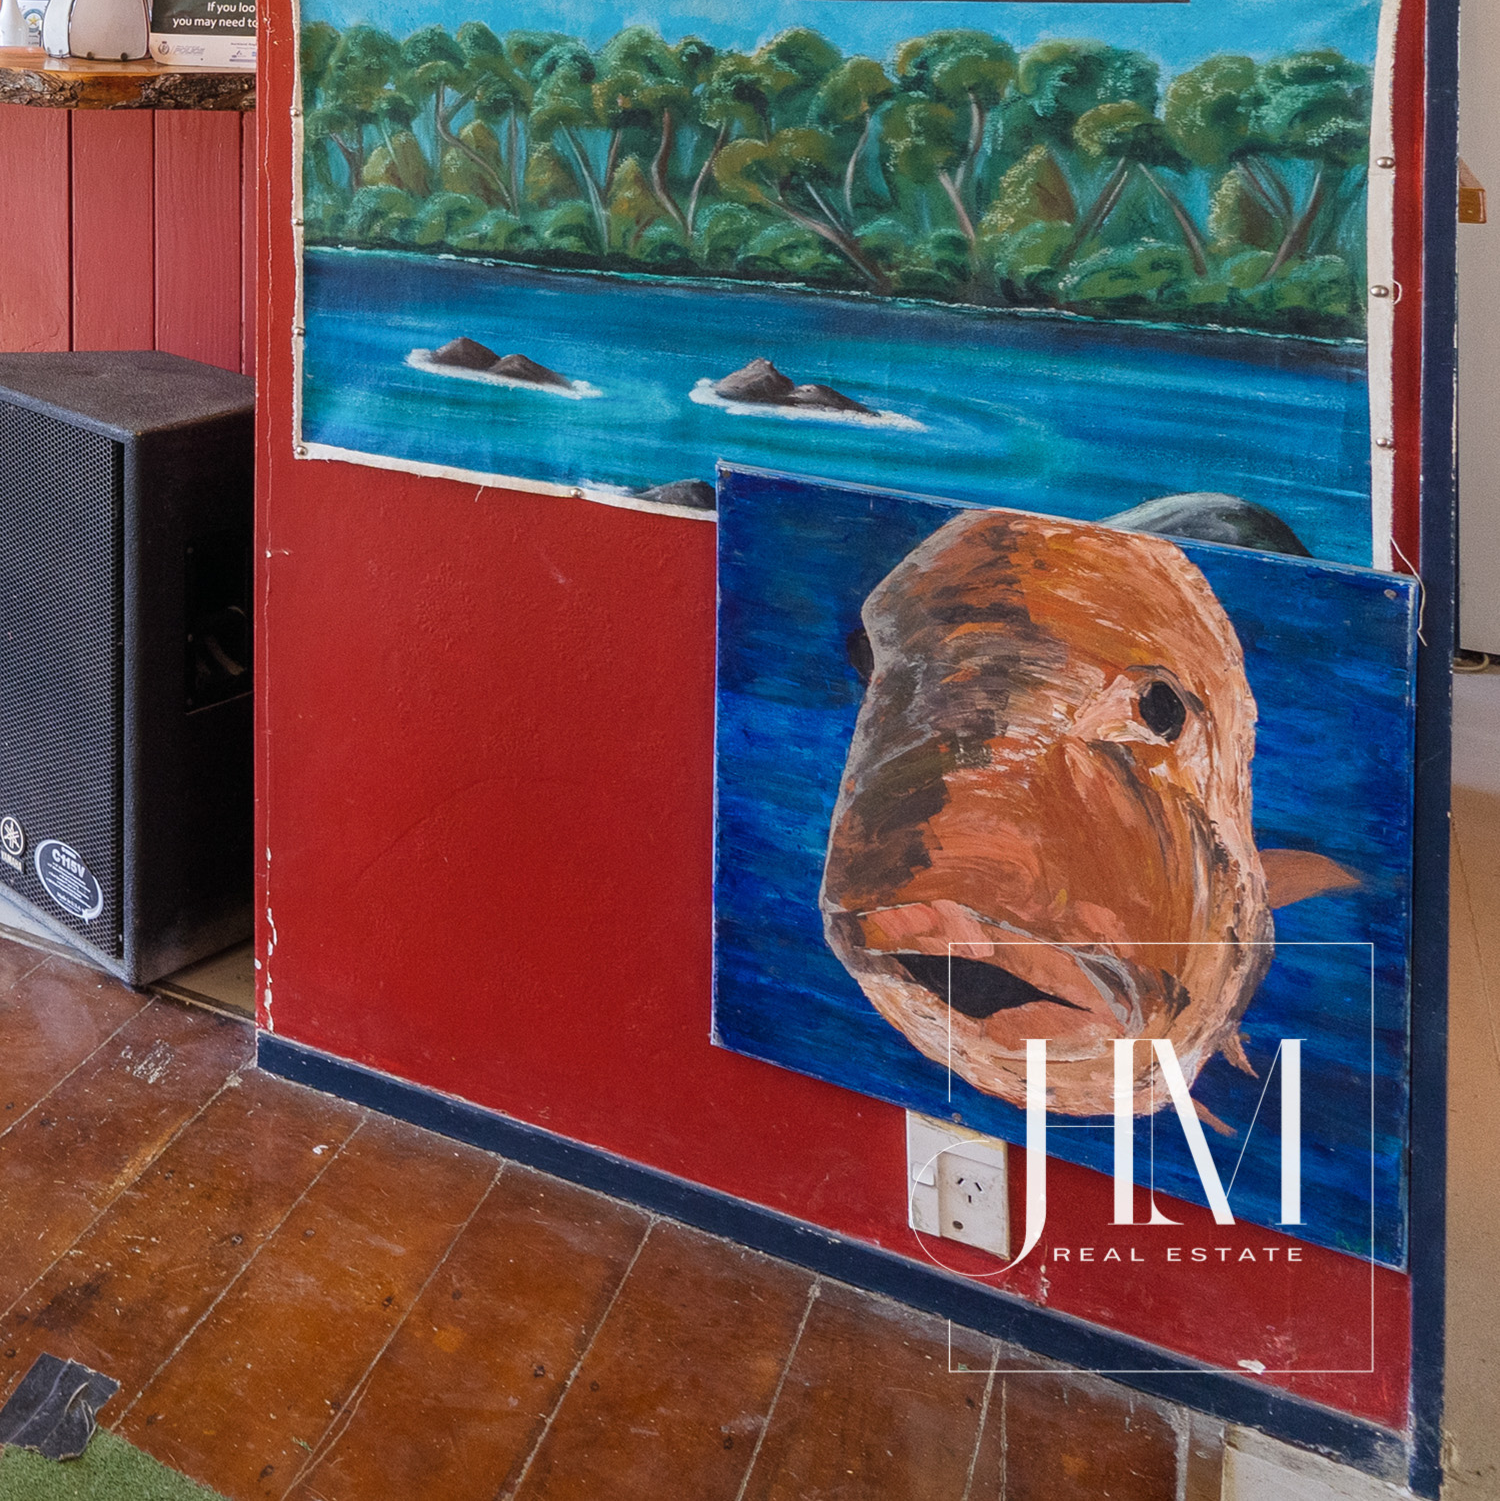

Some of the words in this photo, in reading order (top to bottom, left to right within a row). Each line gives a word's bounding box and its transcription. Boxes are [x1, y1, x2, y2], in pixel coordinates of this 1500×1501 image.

[207, 2, 216, 11] If
[216, 4, 236, 14] you
[239, 2, 255, 12] loo
[173, 18, 192, 27] you
[194, 18, 217, 28] may
[219, 18, 245, 27] need
[1, 850, 23, 871] YAMAHA
